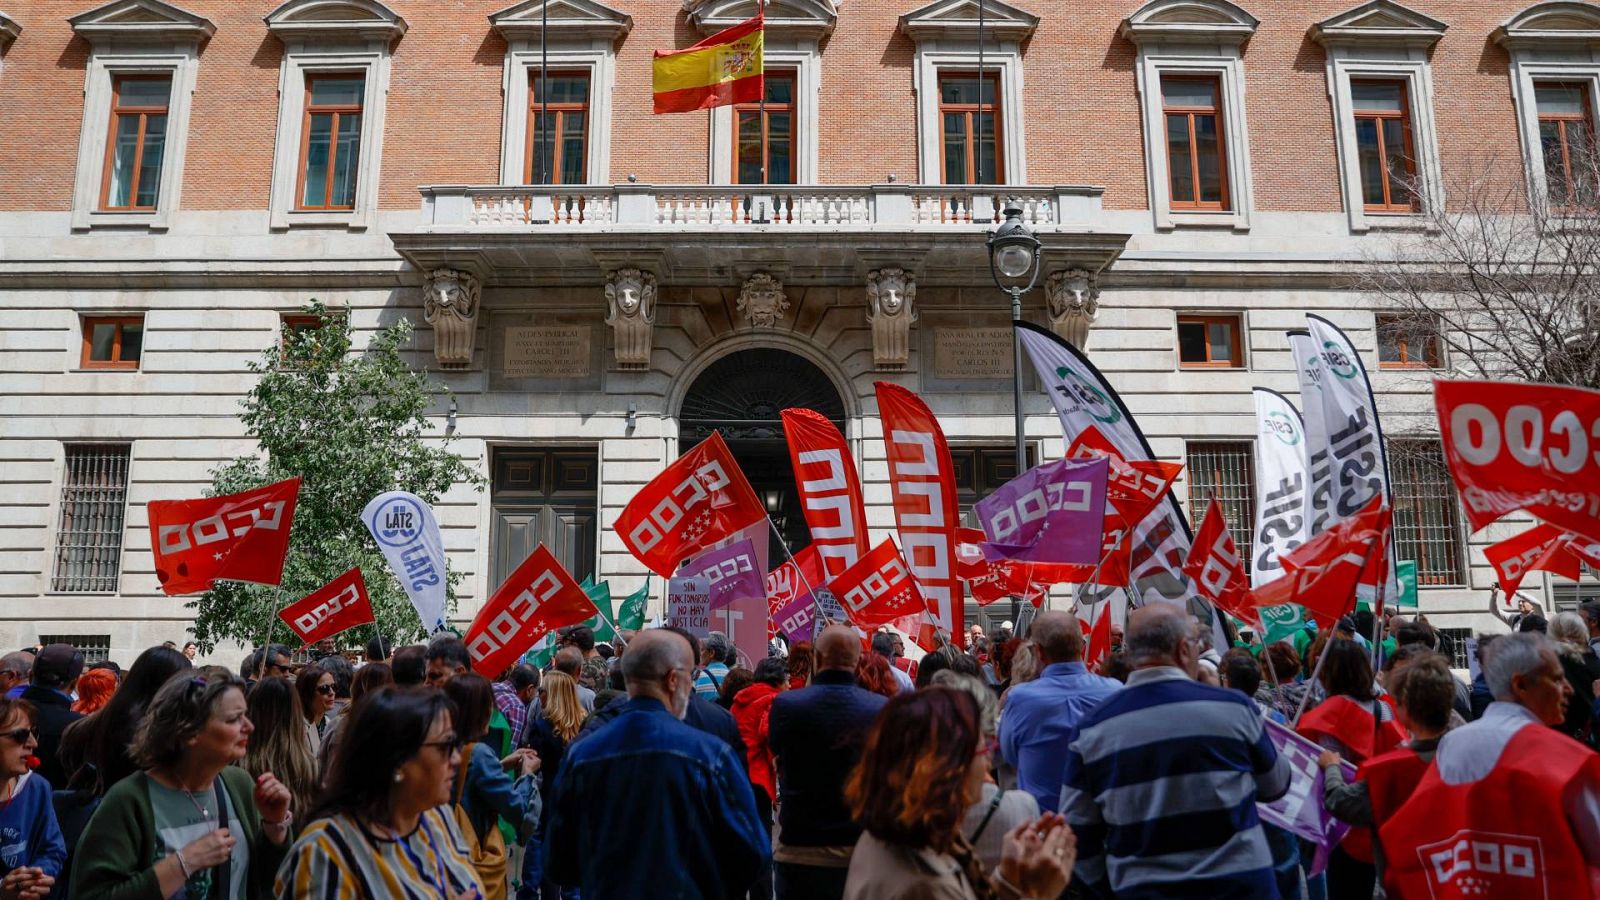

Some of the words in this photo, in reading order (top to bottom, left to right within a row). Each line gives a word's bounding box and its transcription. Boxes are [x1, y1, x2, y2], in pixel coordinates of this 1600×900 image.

[683, 582, 696, 592] SIN
[669, 593, 710, 604] FUNCIONARIOS
[677, 605, 687, 616] NO
[690, 605, 705, 616] HAY
[672, 617, 709, 627] JUSTICIA
[1430, 840, 1536, 885] CCOO
